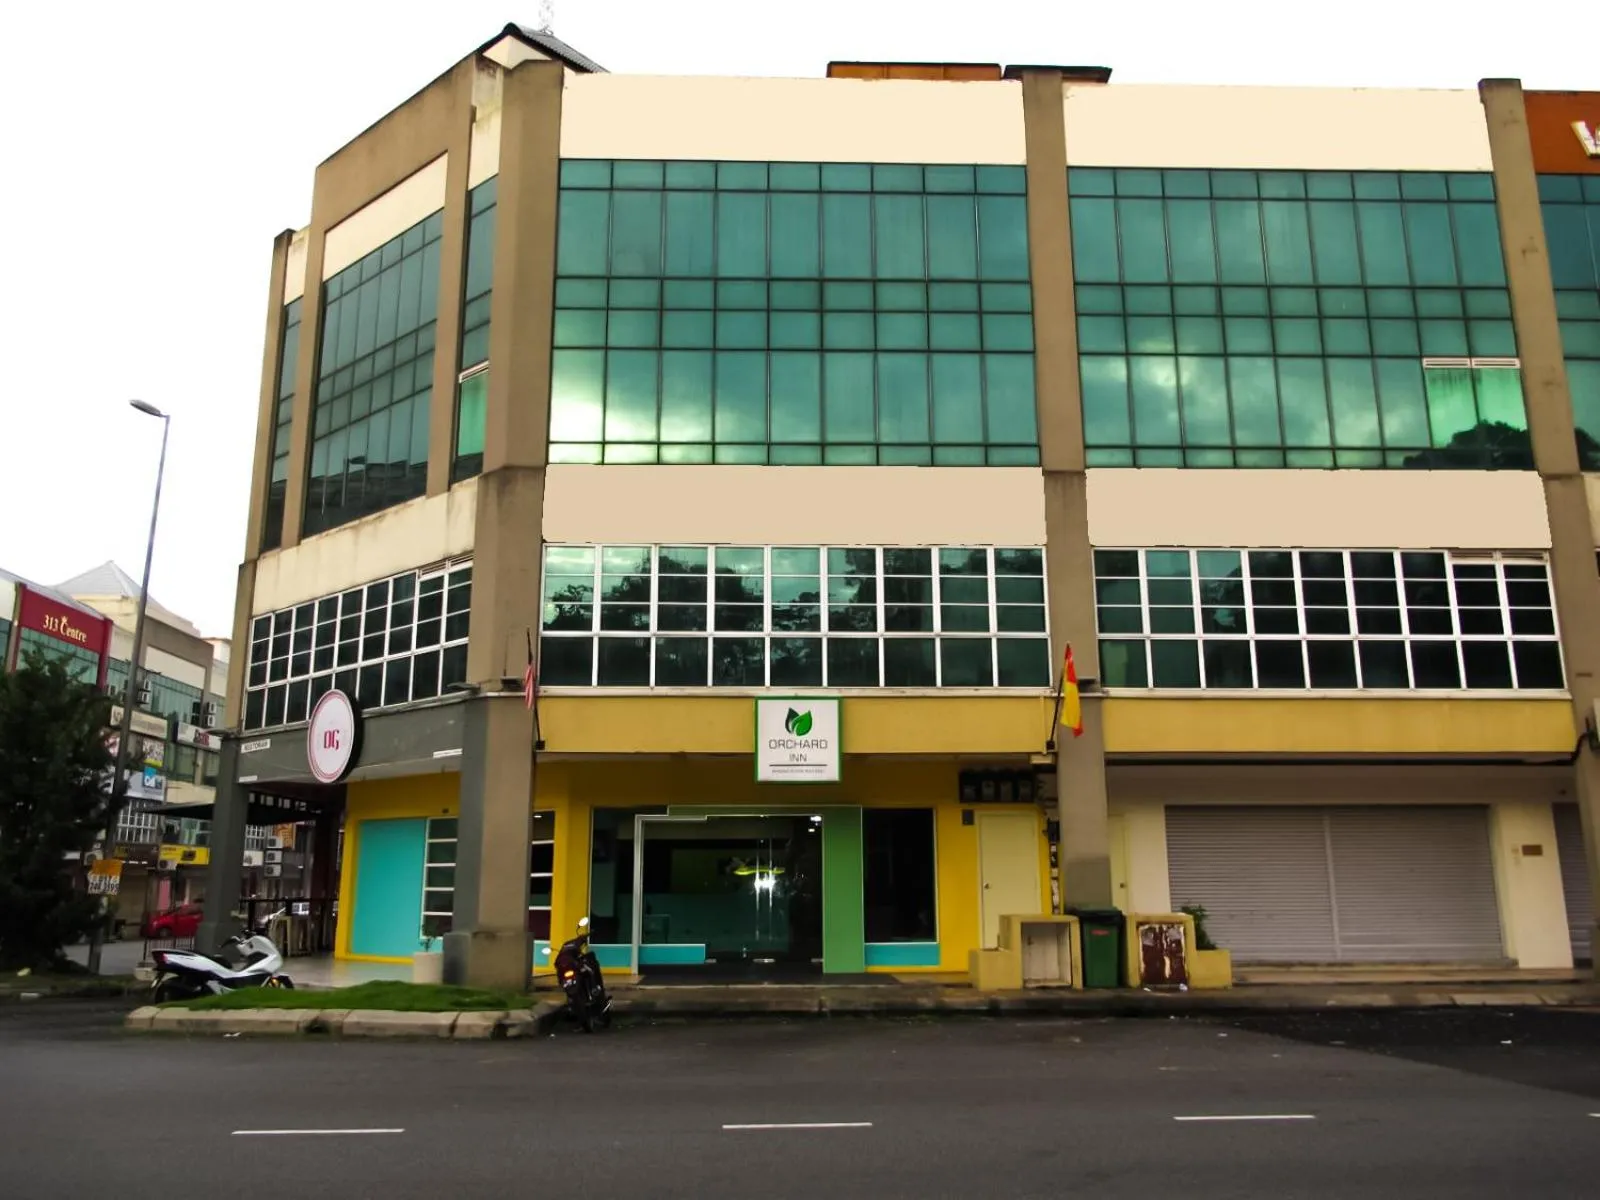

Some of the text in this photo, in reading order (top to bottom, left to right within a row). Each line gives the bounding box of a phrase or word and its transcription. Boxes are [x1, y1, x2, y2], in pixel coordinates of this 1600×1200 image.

[43, 614, 87, 643] 313 Centre
[768, 739, 828, 750] ORCHARD
[789, 753, 808, 762] INN
